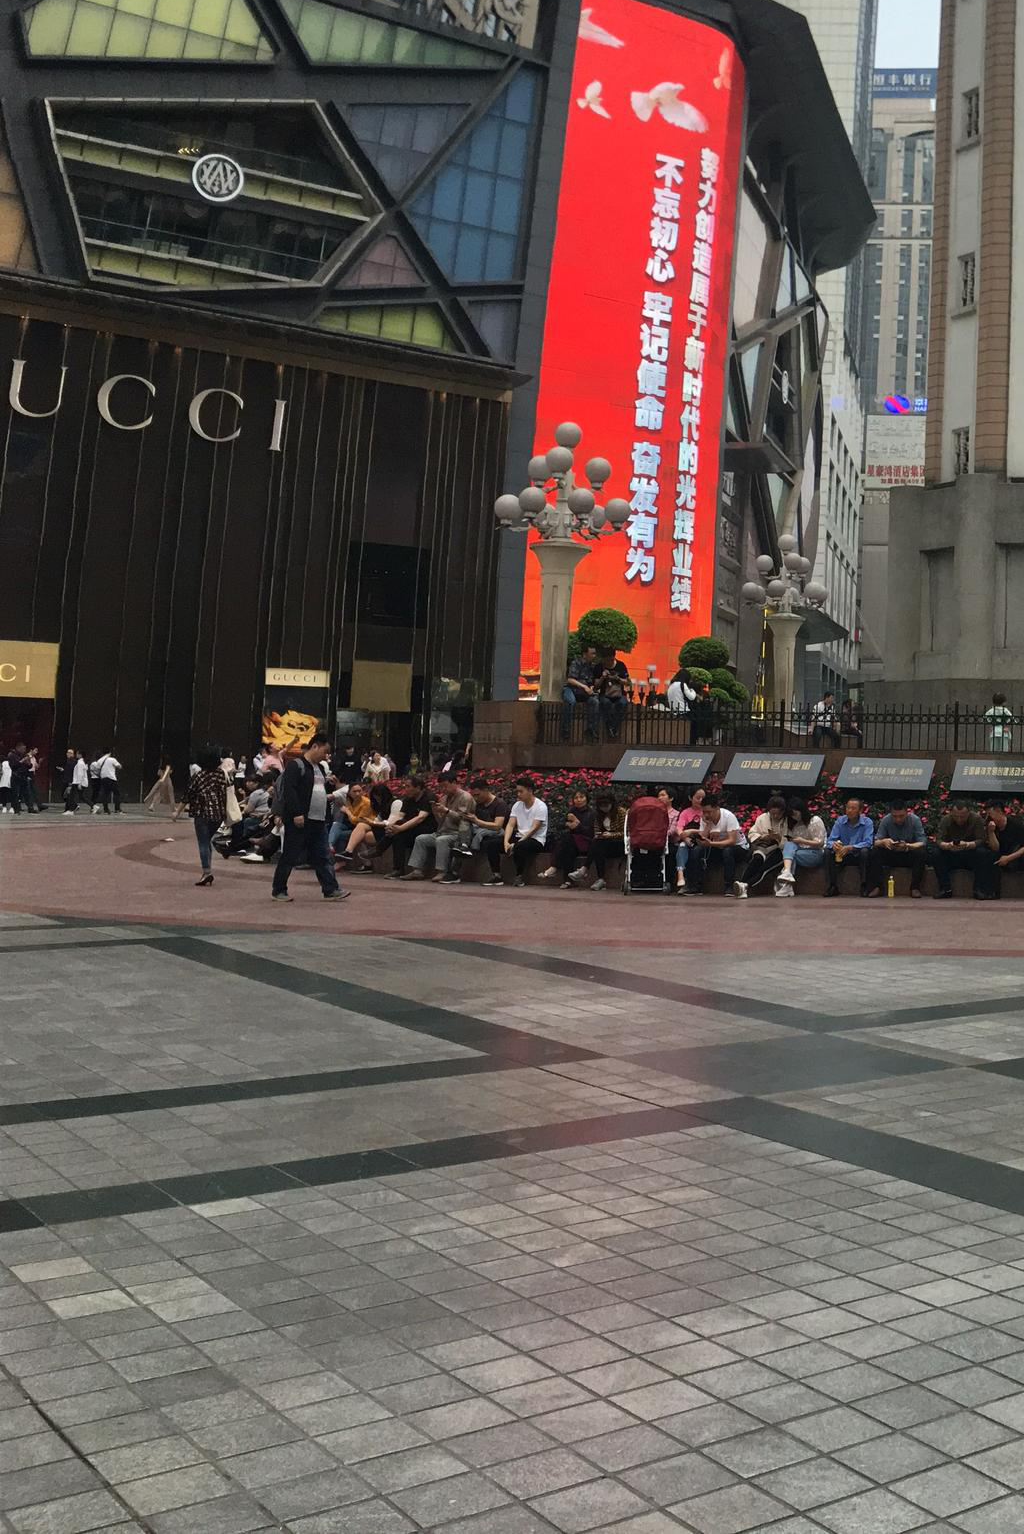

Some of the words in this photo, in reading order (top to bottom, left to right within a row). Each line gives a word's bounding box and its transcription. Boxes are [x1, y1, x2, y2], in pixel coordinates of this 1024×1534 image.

[645, 153, 685, 283] 不忘初心
[634, 291, 673, 431] 牢记使命
[671, 148, 719, 613] 努力创造属于新时代的光辉业绩
[624, 441, 661, 582] 奋发有为
[273, 673, 317, 683] GUCCI
